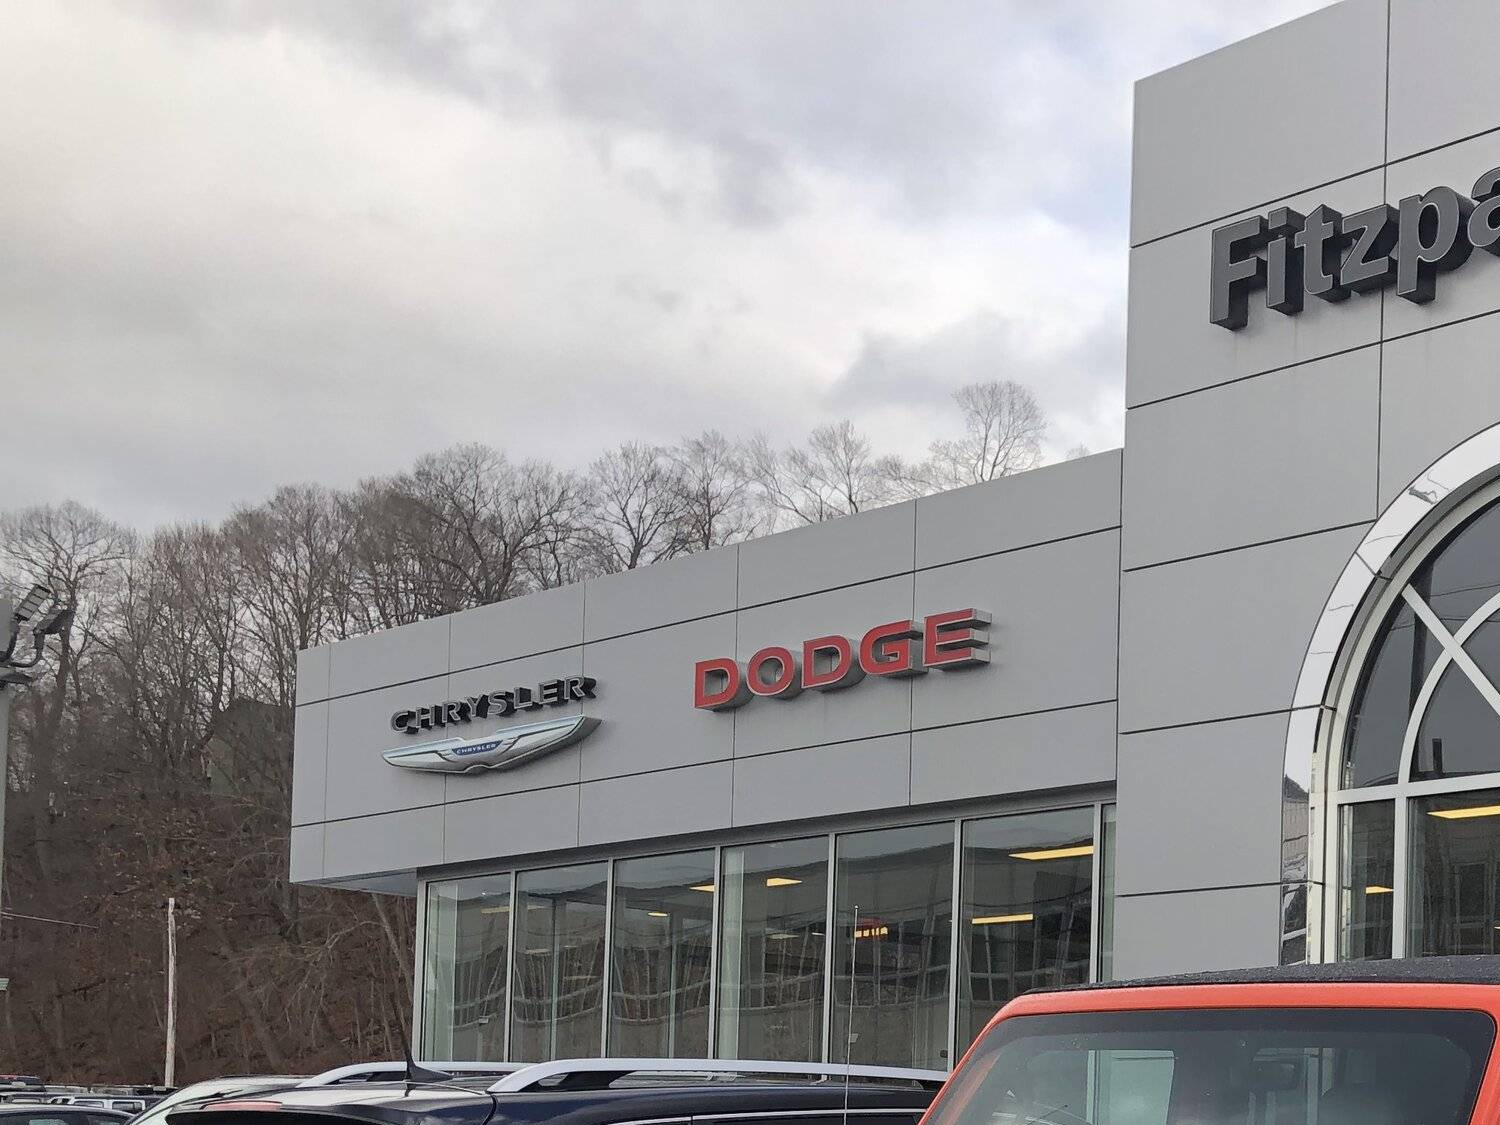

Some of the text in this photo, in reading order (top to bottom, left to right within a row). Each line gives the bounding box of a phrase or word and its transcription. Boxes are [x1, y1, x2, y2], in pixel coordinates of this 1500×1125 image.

[694, 608, 992, 712] DODGE
[389, 675, 597, 735] CHRYSLER
[456, 743, 498, 756] CHRYSLER
